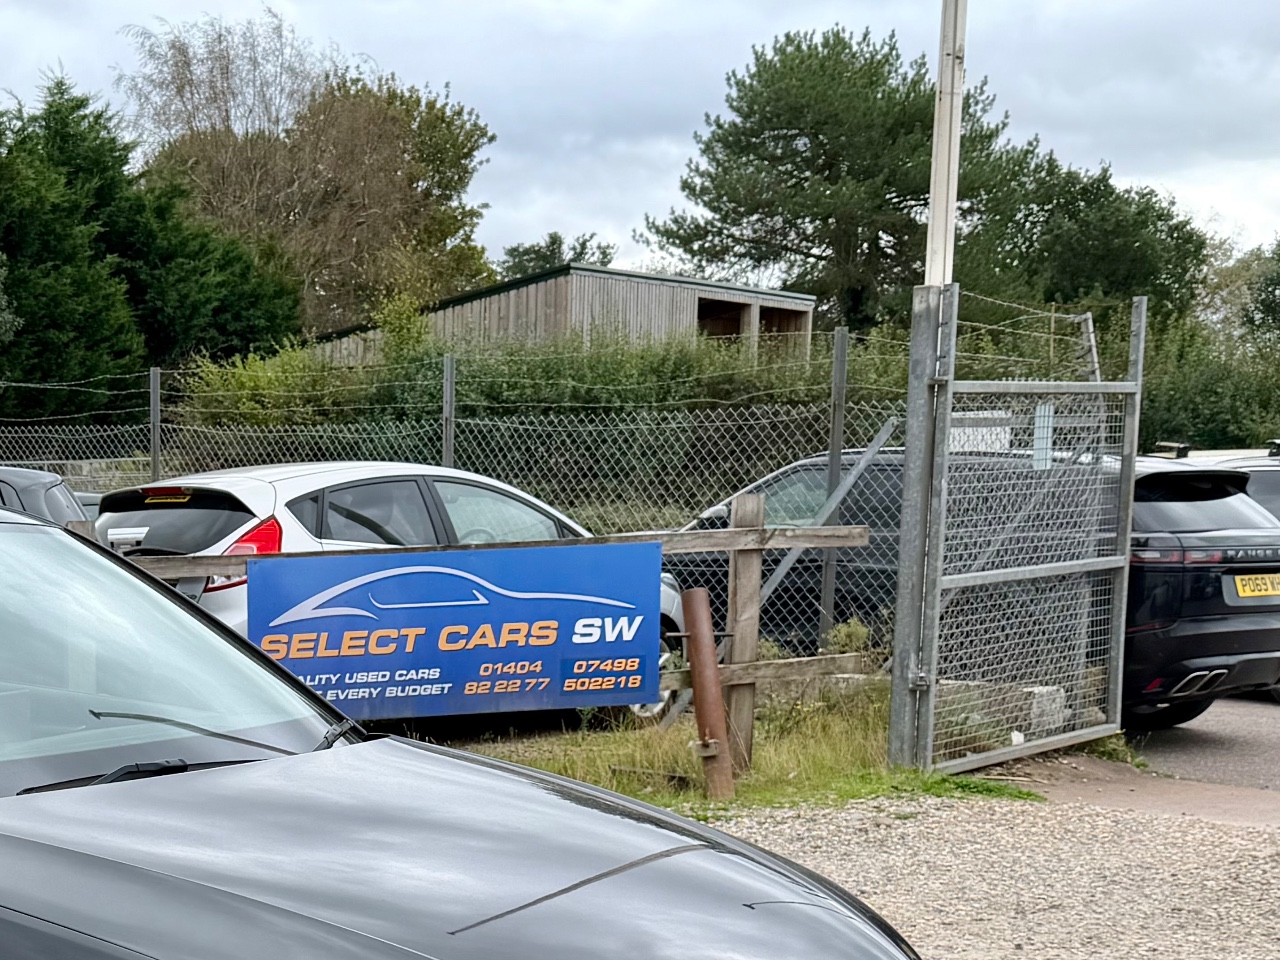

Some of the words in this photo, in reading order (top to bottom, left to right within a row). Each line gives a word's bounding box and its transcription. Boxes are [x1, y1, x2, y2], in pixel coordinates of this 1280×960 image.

[260, 627, 426, 661] SELECT
[437, 620, 559, 651] CARS
[571, 615, 644, 644] SW
[479, 660, 543, 677] 01404
[573, 658, 640, 674] 07498
[344, 671, 390, 684] USED
[394, 668, 441, 681] CARS
[563, 675, 642, 692] 502218
[325, 687, 383, 701] EVERY
[384, 683, 453, 698] BUDGET
